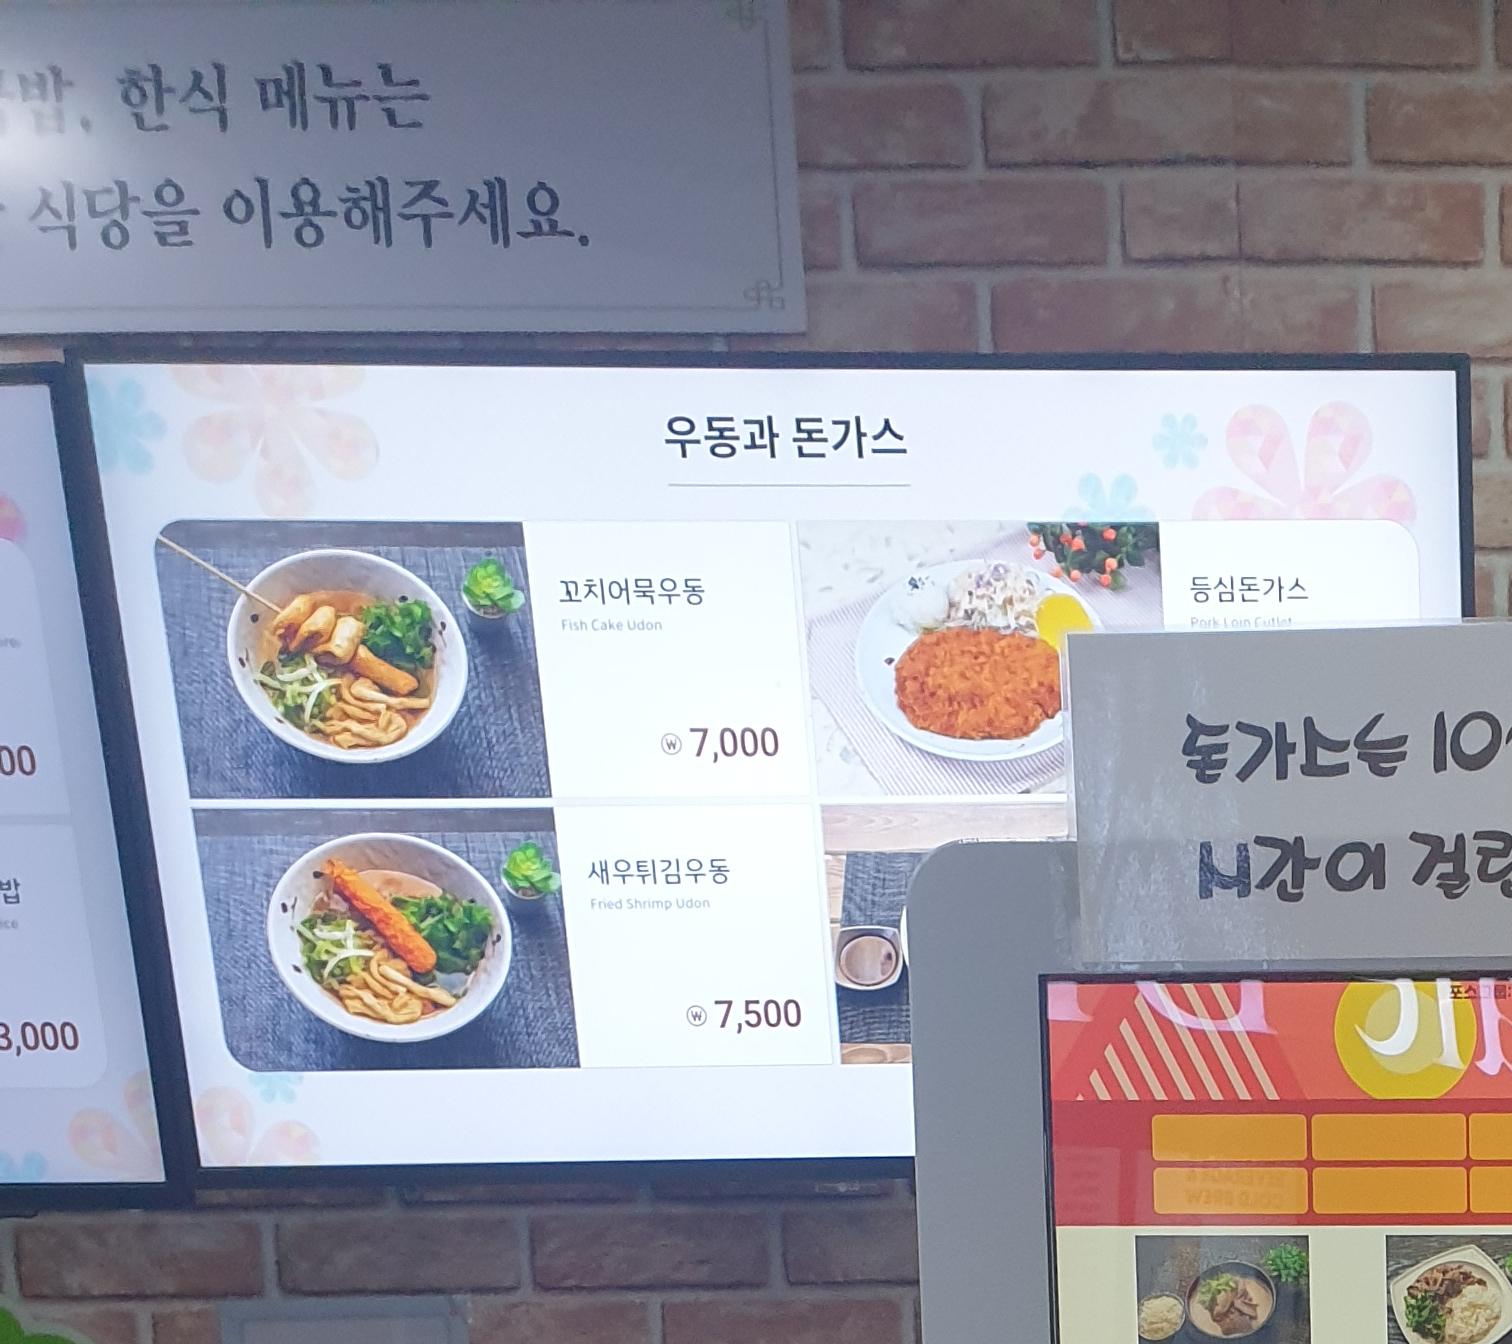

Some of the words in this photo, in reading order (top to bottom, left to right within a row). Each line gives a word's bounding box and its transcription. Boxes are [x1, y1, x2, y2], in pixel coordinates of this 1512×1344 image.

[116, 62, 229, 133] 한식
[258, 60, 431, 131] 메뉴는
[29, 177, 200, 252] 식당을
[222, 175, 591, 250] 이용해주세요.
[664, 416, 780, 460] 우동과
[792, 414, 909, 460] 돈가스
[559, 577, 706, 608] 꼬치어묵우동
[1189, 573, 1309, 605] 등심돈가스
[561, 618, 592, 633] Fish
[594, 618, 624, 633] Cake
[627, 618, 663, 633] Udon
[690, 726, 780, 765] 7,000
[587, 856, 731, 887] 새우튀김우동
[1199, 834, 1386, 903] 시간이
[590, 896, 623, 911] Fried
[626, 896, 673, 914] Shrimp
[676, 896, 711, 911] Udon
[713, 998, 802, 1036] 7,500
